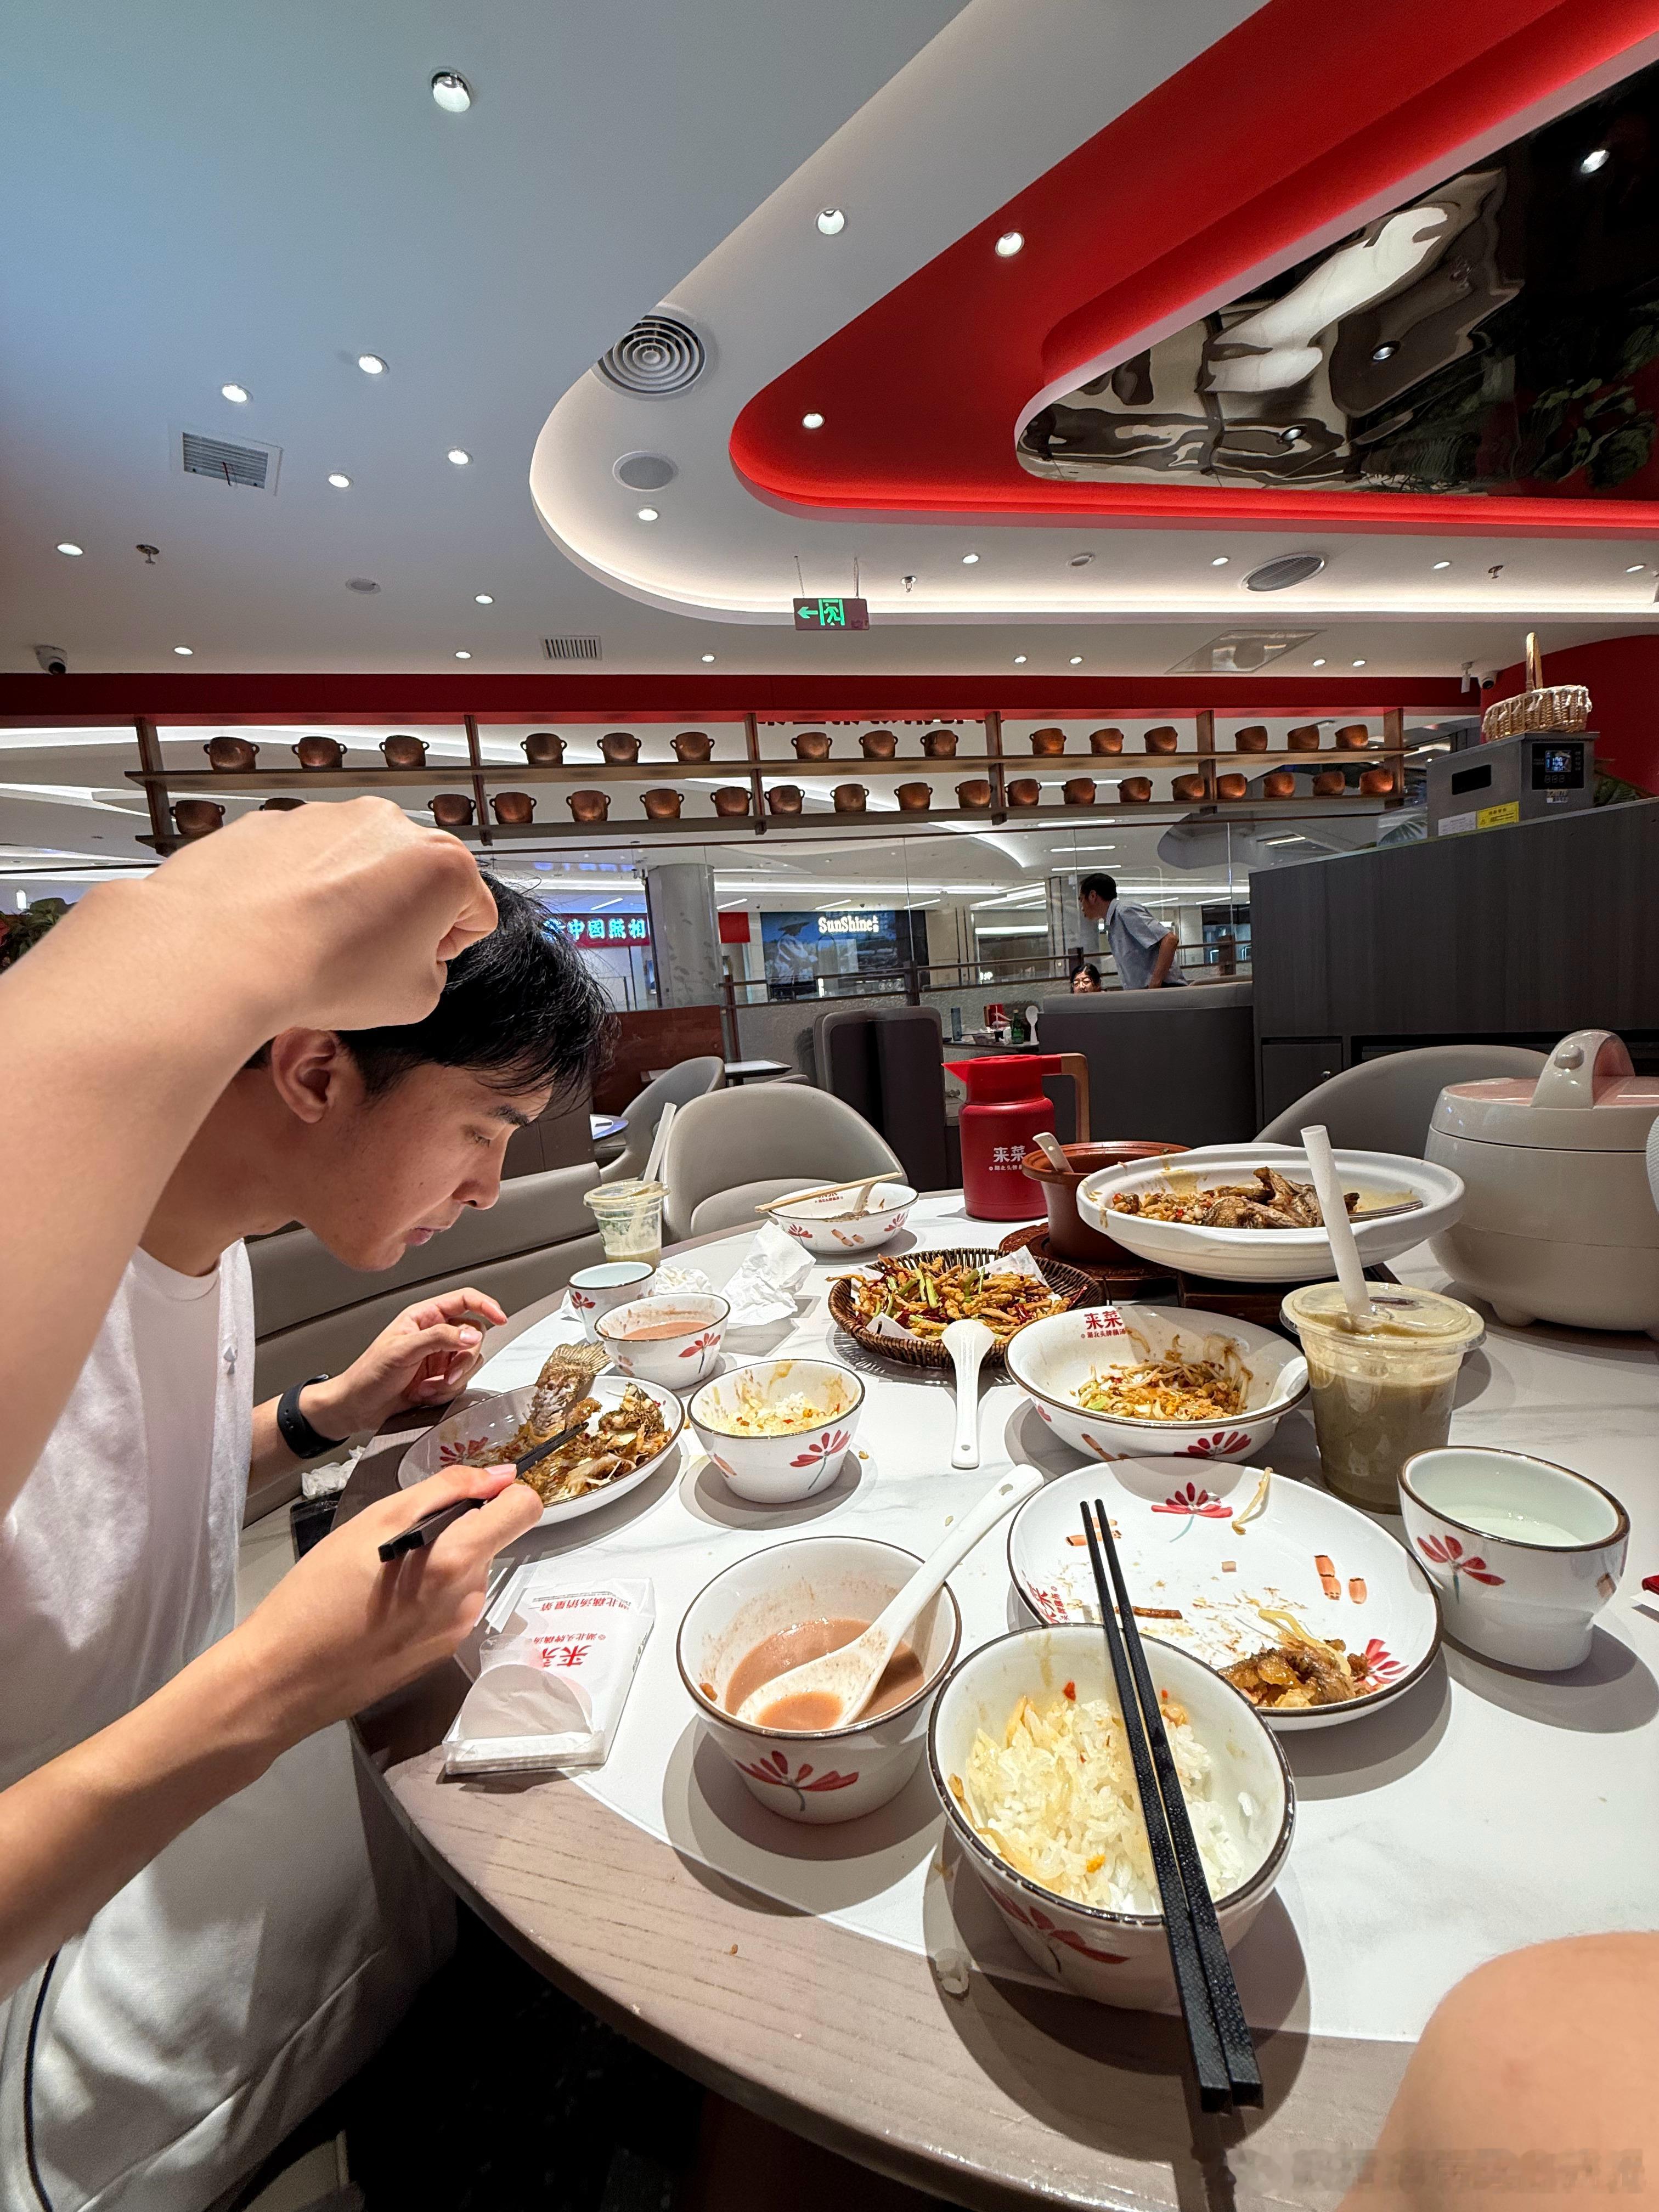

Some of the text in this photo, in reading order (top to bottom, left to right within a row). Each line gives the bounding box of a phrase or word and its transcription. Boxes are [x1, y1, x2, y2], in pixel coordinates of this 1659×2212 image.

[818, 915, 873, 933] SunShine
[992, 1145, 1026, 1163] 来菜
[1084, 1310, 1124, 1330] 来菜
[533, 1633, 598, 1644] 湖北头牌藕汤
